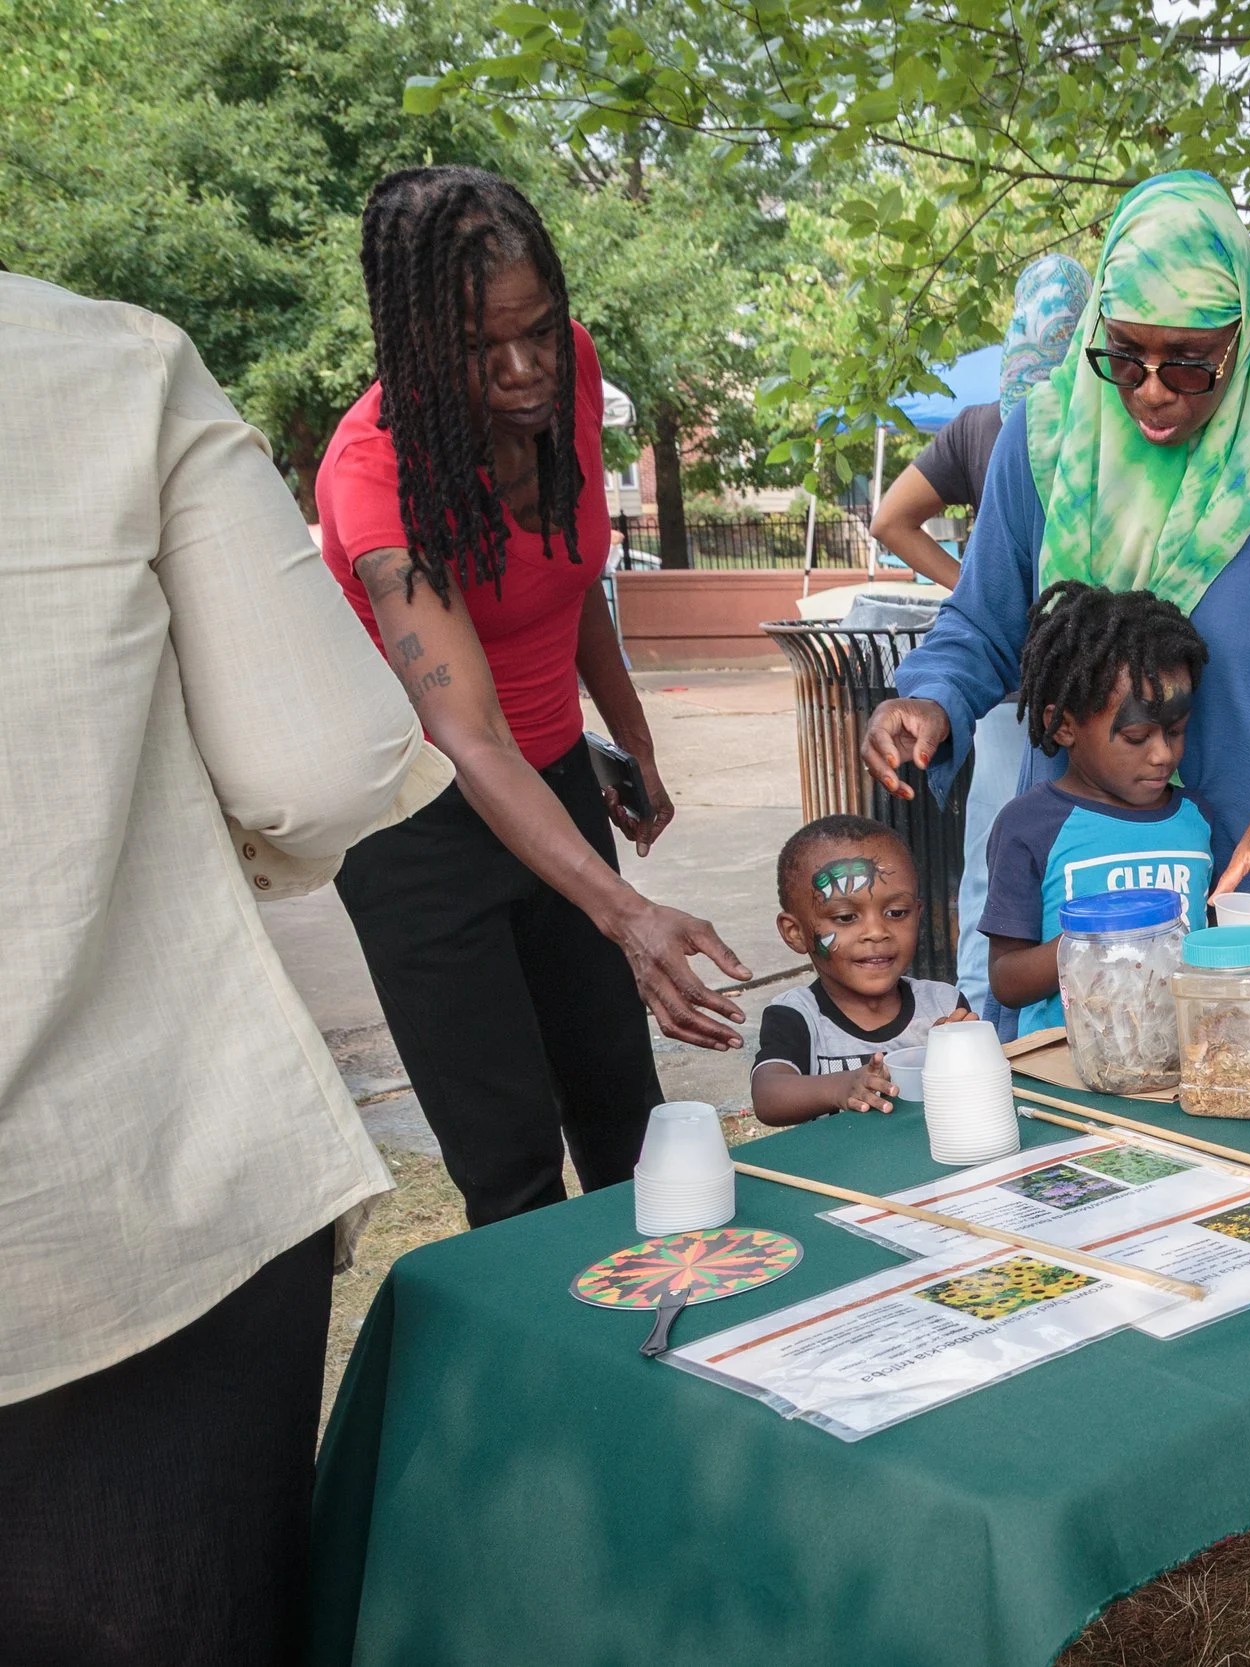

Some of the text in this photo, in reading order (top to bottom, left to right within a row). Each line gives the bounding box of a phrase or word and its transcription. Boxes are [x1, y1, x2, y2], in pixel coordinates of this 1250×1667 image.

[1107, 864, 1191, 894] CLEAR
[1035, 1283, 1113, 1312] Brown-Eyed
[917, 1310, 1037, 1359] Susan/Rudbeckia
[861, 1359, 915, 1382] triloba
